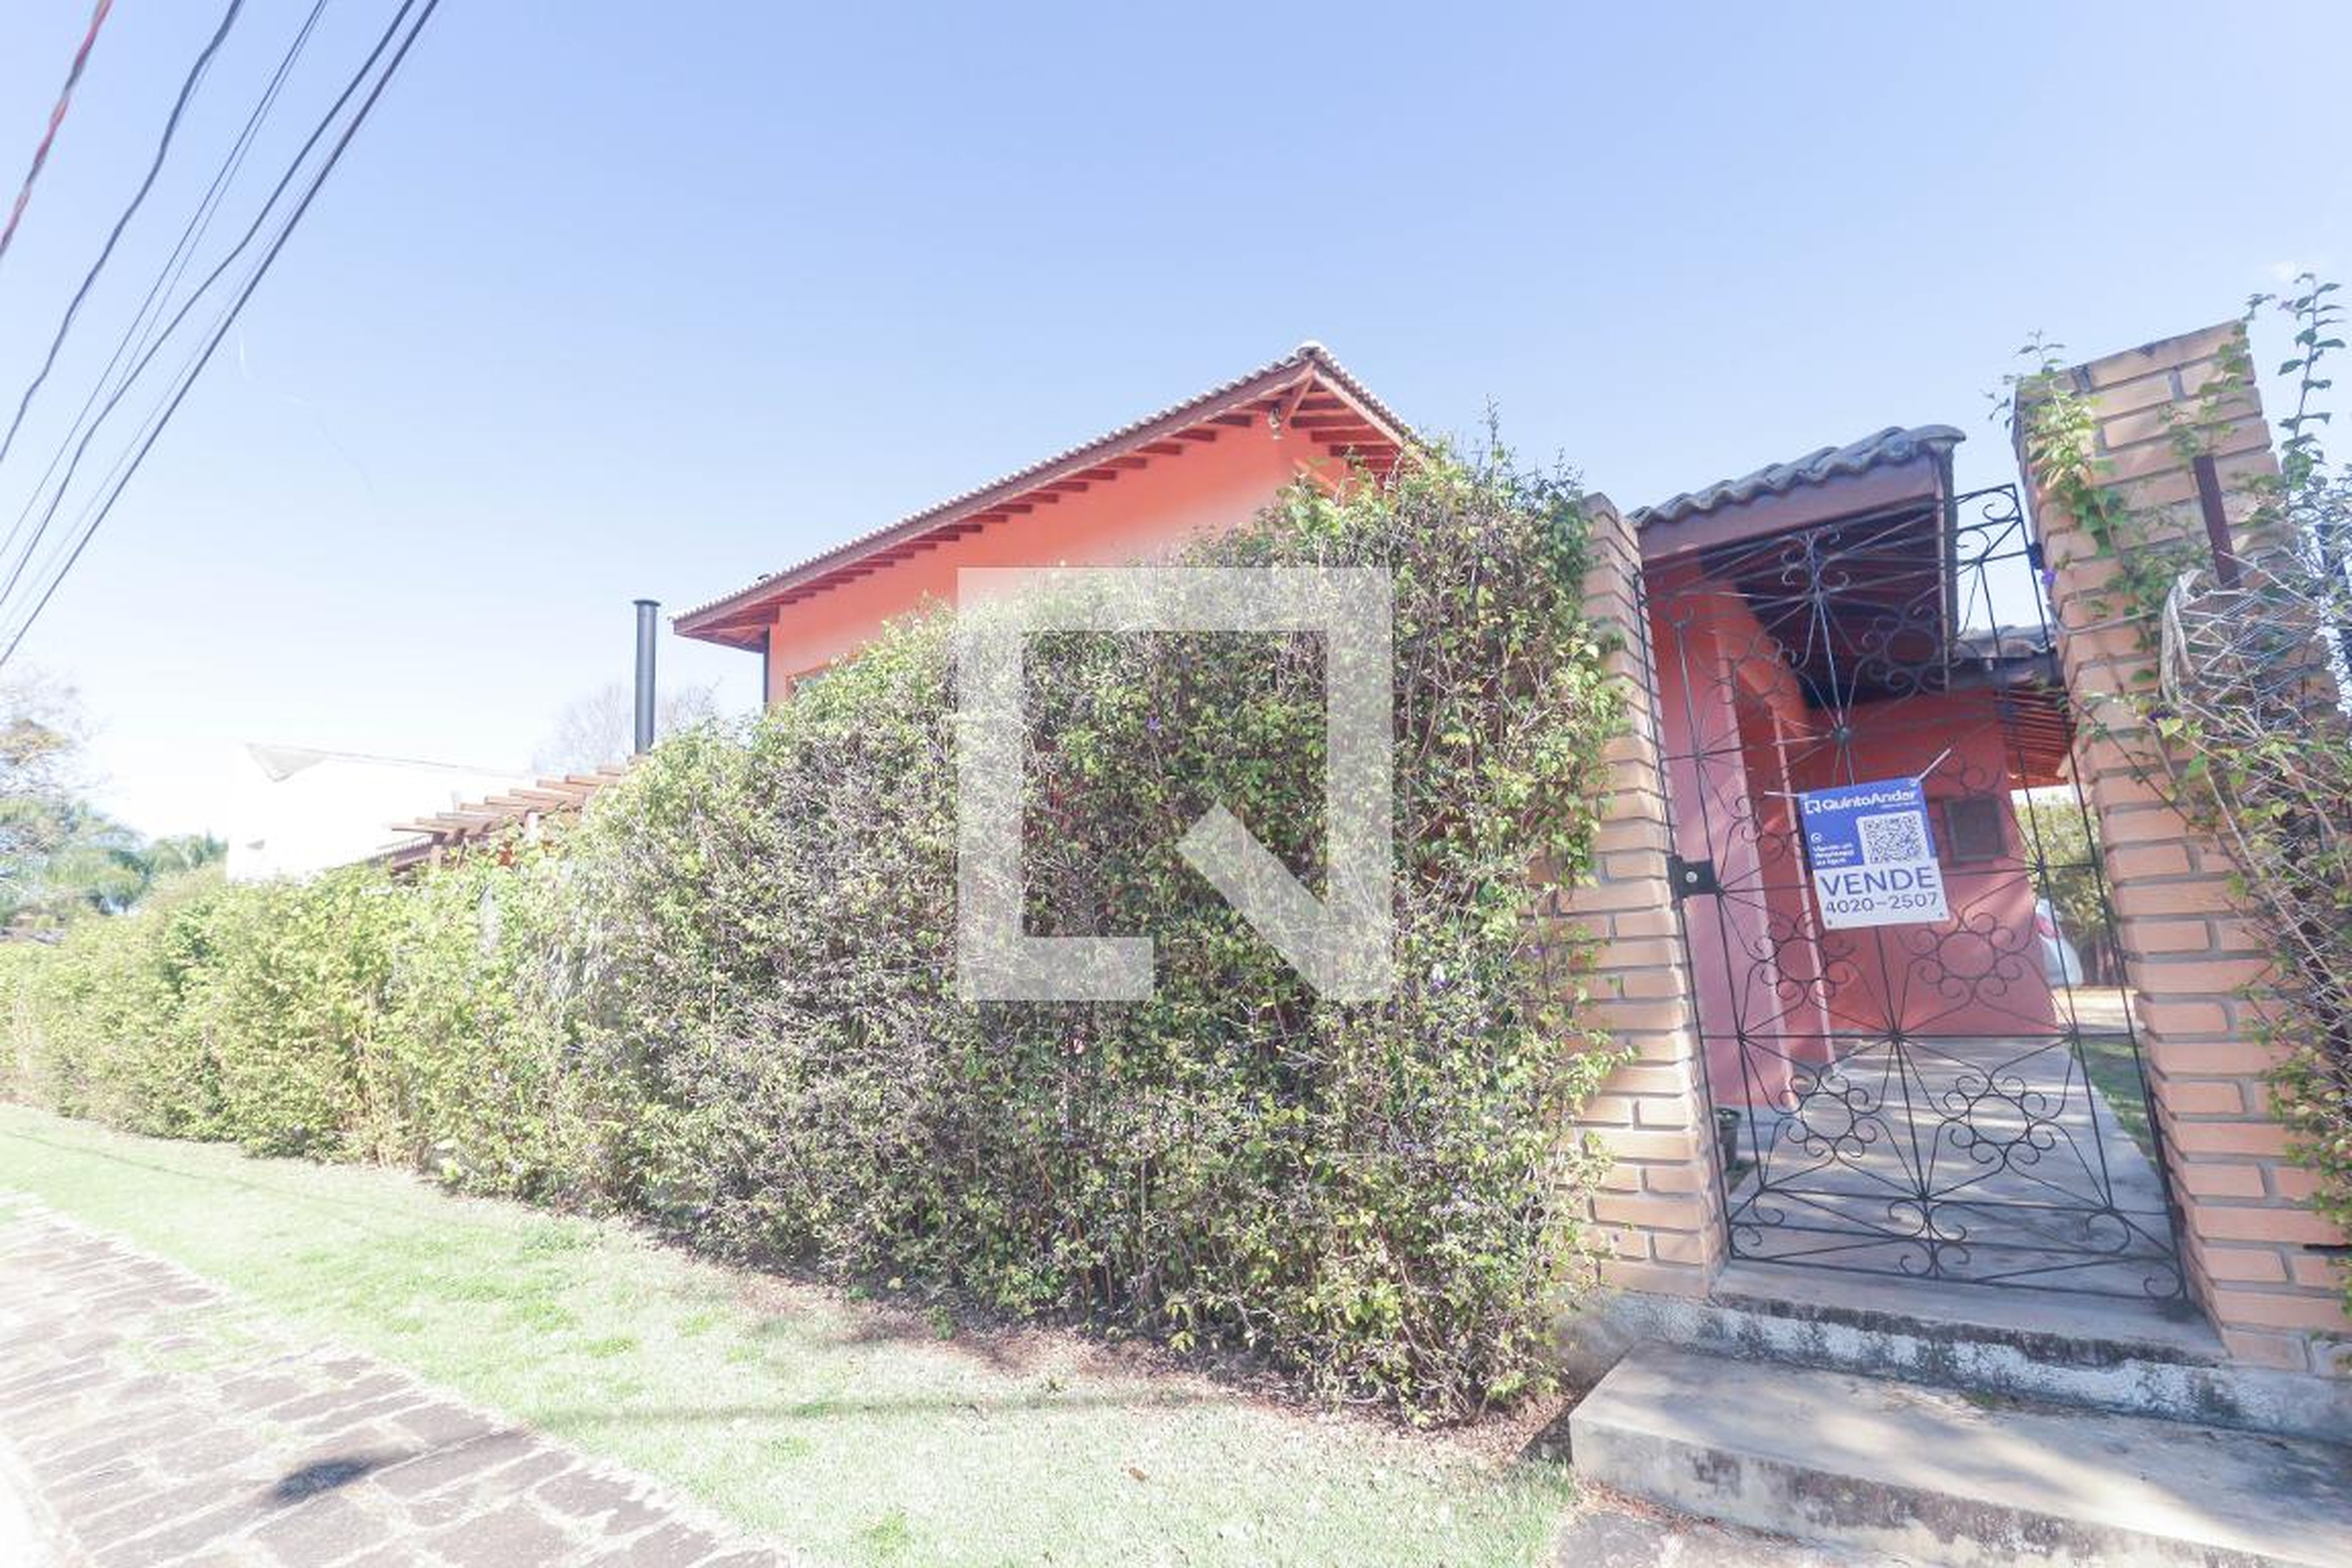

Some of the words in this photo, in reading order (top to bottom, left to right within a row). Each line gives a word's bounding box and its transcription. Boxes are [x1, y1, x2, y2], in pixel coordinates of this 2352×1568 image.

[1822, 790, 1915, 810] QuintoAndar
[1820, 867, 1936, 895] VENDE
[1826, 892, 1937, 913] 4020-2507
